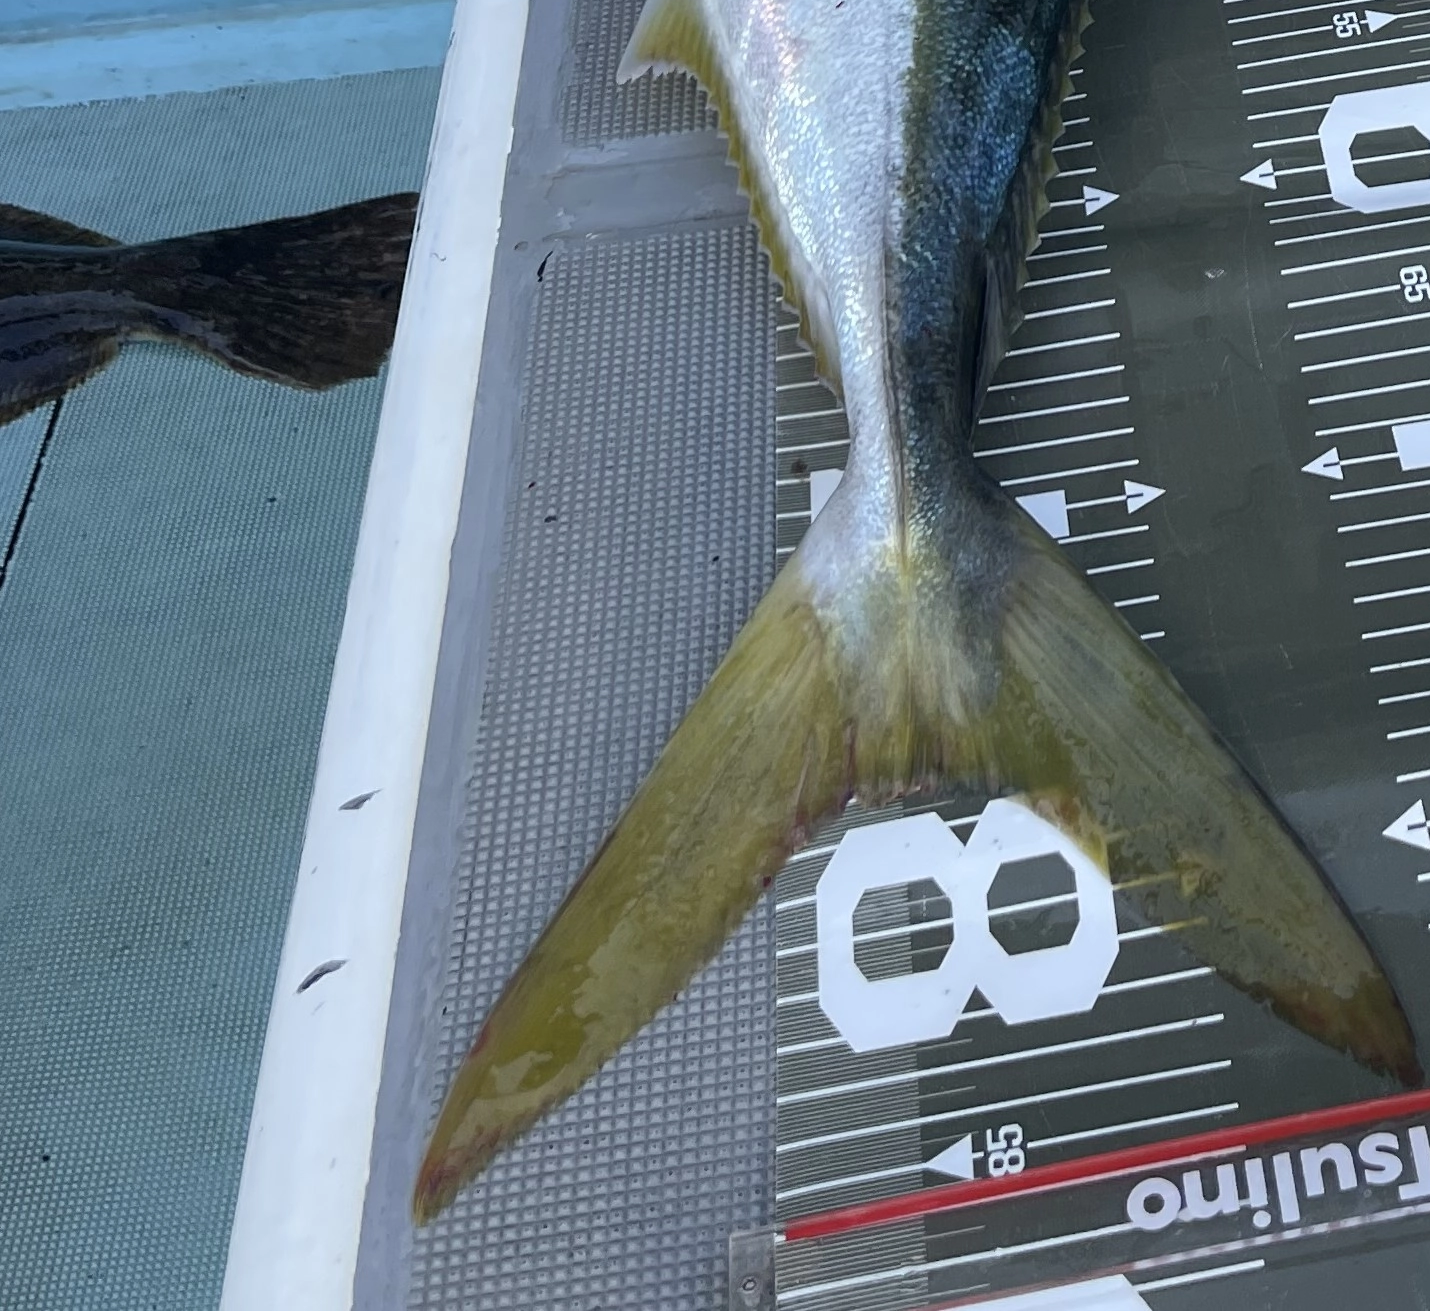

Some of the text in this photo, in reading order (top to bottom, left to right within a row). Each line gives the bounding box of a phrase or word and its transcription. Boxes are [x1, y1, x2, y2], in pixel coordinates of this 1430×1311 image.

[1333, 11, 1361, 38] 55
[816, 798, 1119, 1053] 8
[987, 1123, 1025, 1177] 85
